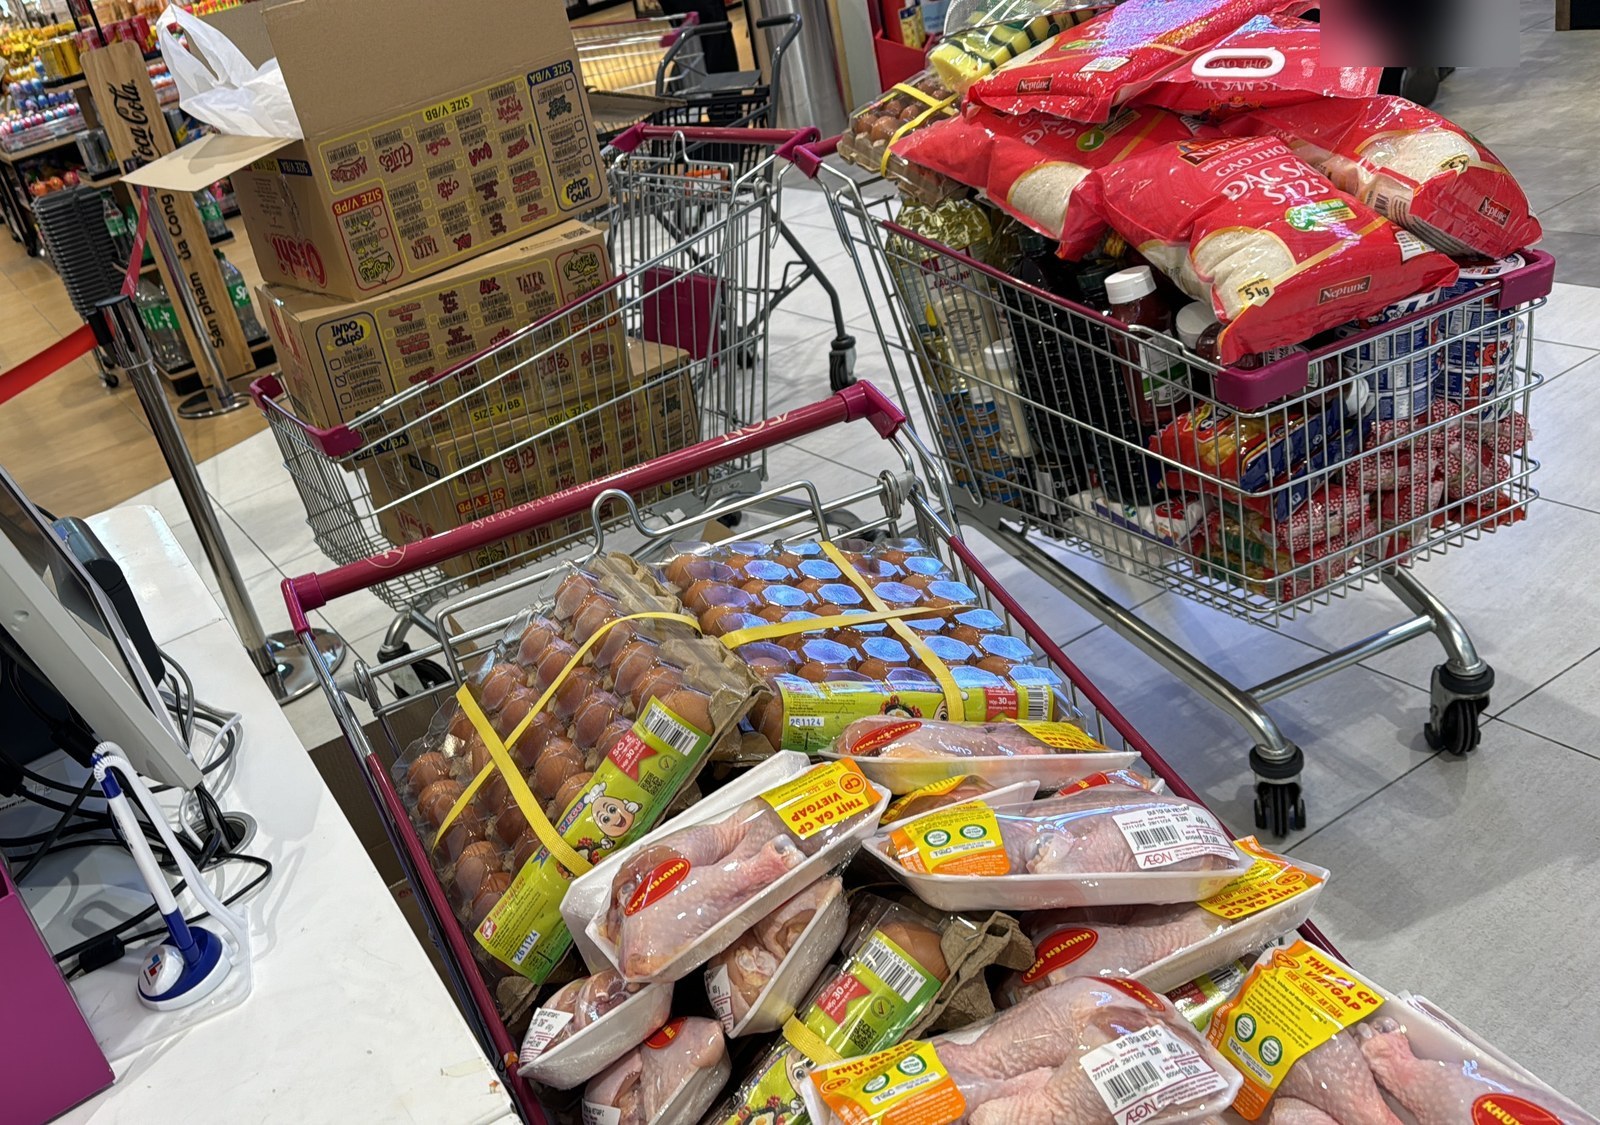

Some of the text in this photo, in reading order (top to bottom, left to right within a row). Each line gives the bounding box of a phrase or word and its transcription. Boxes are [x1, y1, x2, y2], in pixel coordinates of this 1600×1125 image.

[552, 61, 571, 77] SIZE
[1019, 78, 1051, 91] Neptune
[425, 97, 471, 121] SIZE V/BB
[1263, 178, 1330, 205] ST25
[333, 188, 383, 214] SIZE V/PB
[1244, 288, 1256, 301] 5
[1257, 284, 1271, 298] kg
[1321, 281, 1367, 300] Neptune
[330, 320, 358, 337] INDO
[473, 407, 496, 421] SIZE
[499, 508, 517, 520] XE
[997, 696, 1008, 705] 30
[625, 749, 635, 760] 30
[844, 777, 861, 790] CP
[791, 792, 843, 823] VIETGAP
[837, 797, 864, 816] THỊT
[797, 821, 815, 835] CP
[1280, 874, 1301, 885] CP
[1217, 887, 1278, 911] VIETGAP
[1224, 907, 1243, 917] CP
[513, 929, 539, 962] 261124
[1275, 953, 1296, 967] CP
[833, 985, 844, 999] 30
[1304, 969, 1362, 1012] VIETGAP
[1356, 990, 1379, 1006] CP
[825, 1080, 847, 1092] CP
